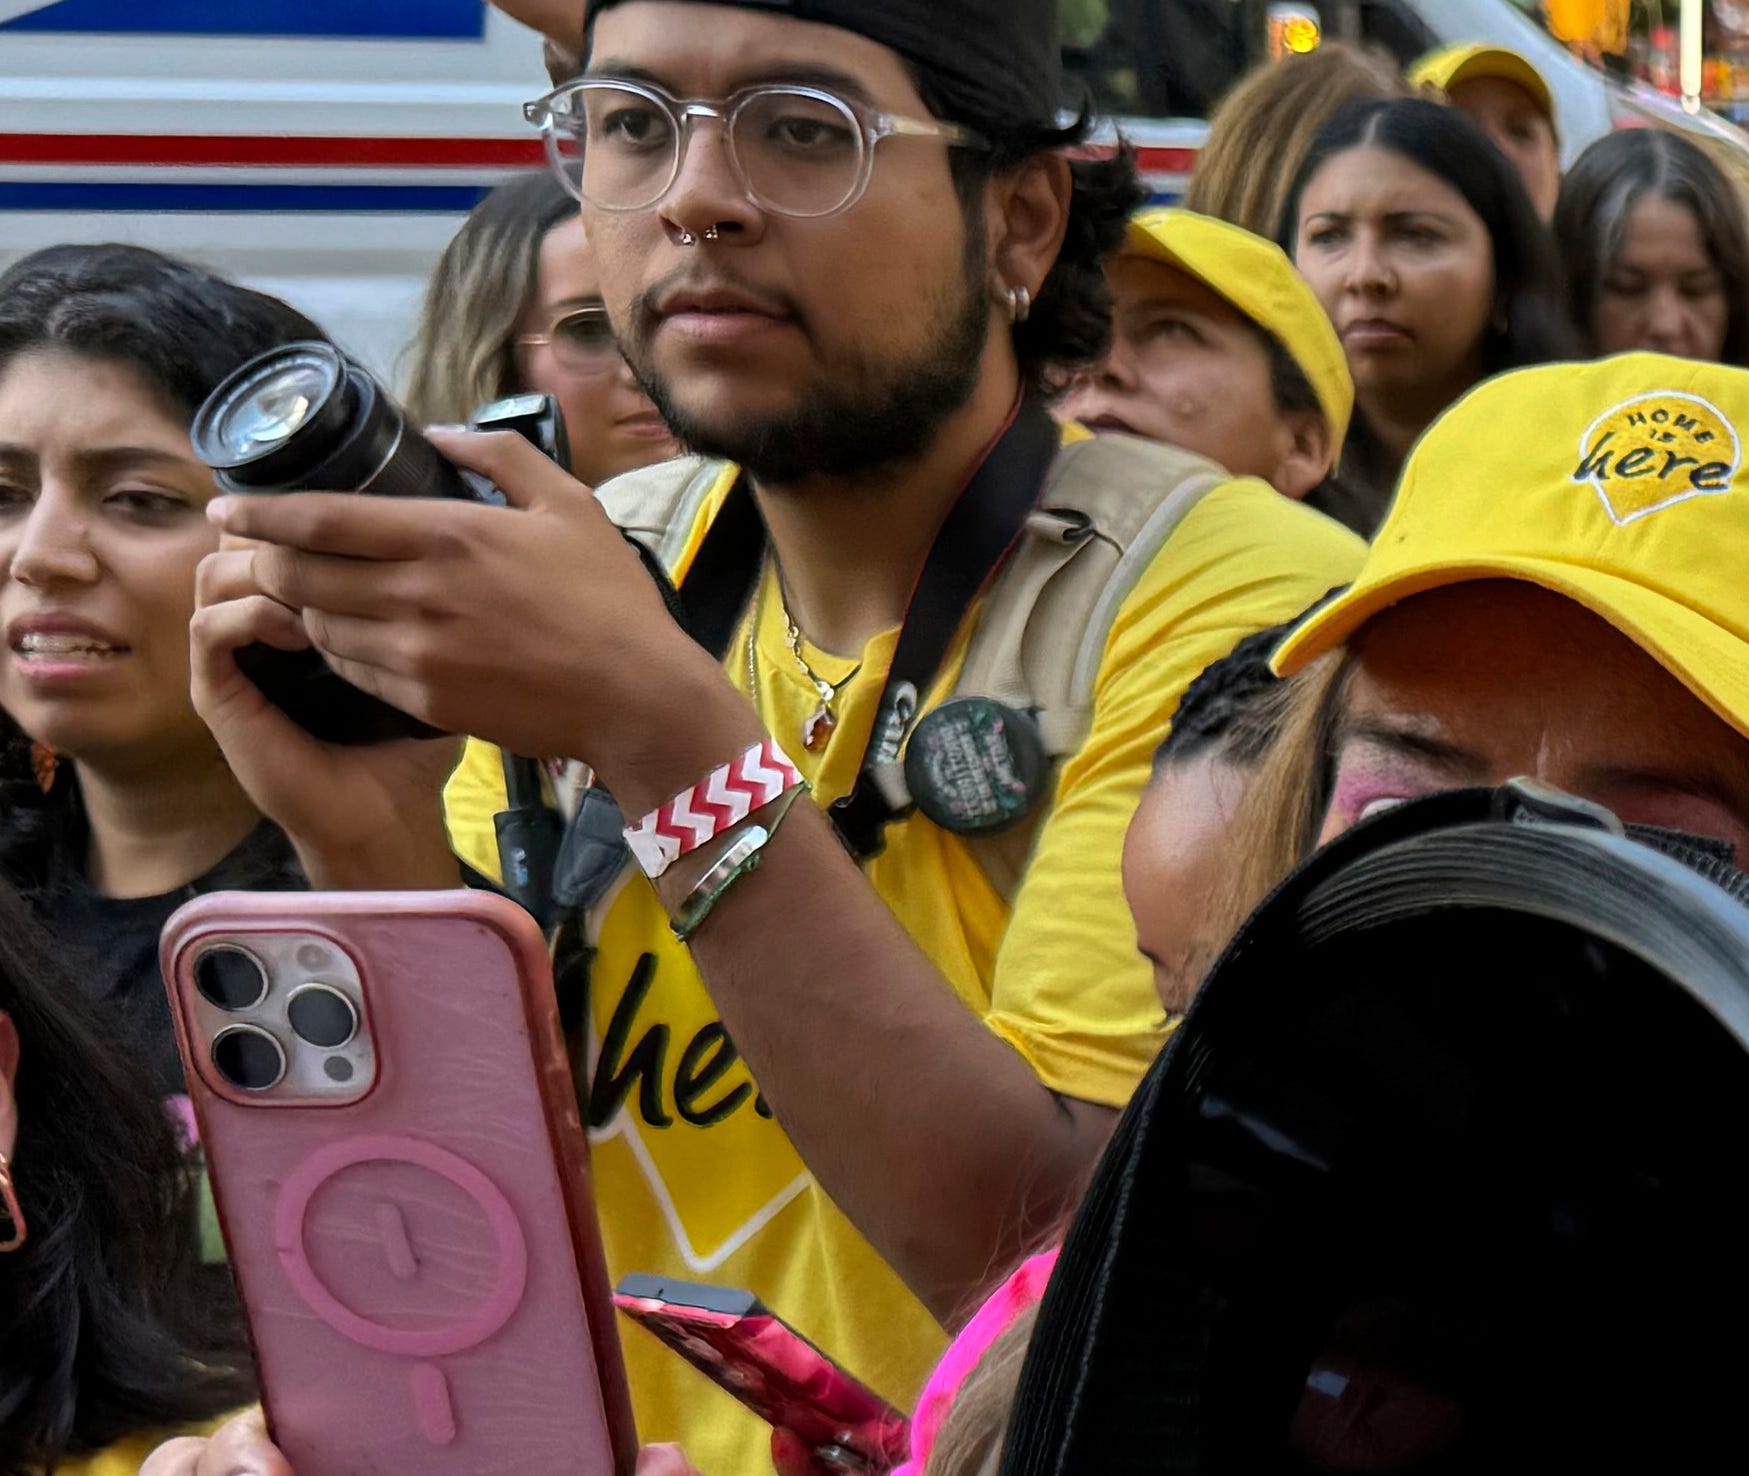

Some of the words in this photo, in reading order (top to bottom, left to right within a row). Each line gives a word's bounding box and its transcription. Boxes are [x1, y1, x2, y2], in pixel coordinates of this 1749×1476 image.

[1627, 409, 1715, 444] HOME
[1649, 428, 1677, 443] IS
[1573, 431, 1732, 491] here
[588, 952, 773, 1129] he
